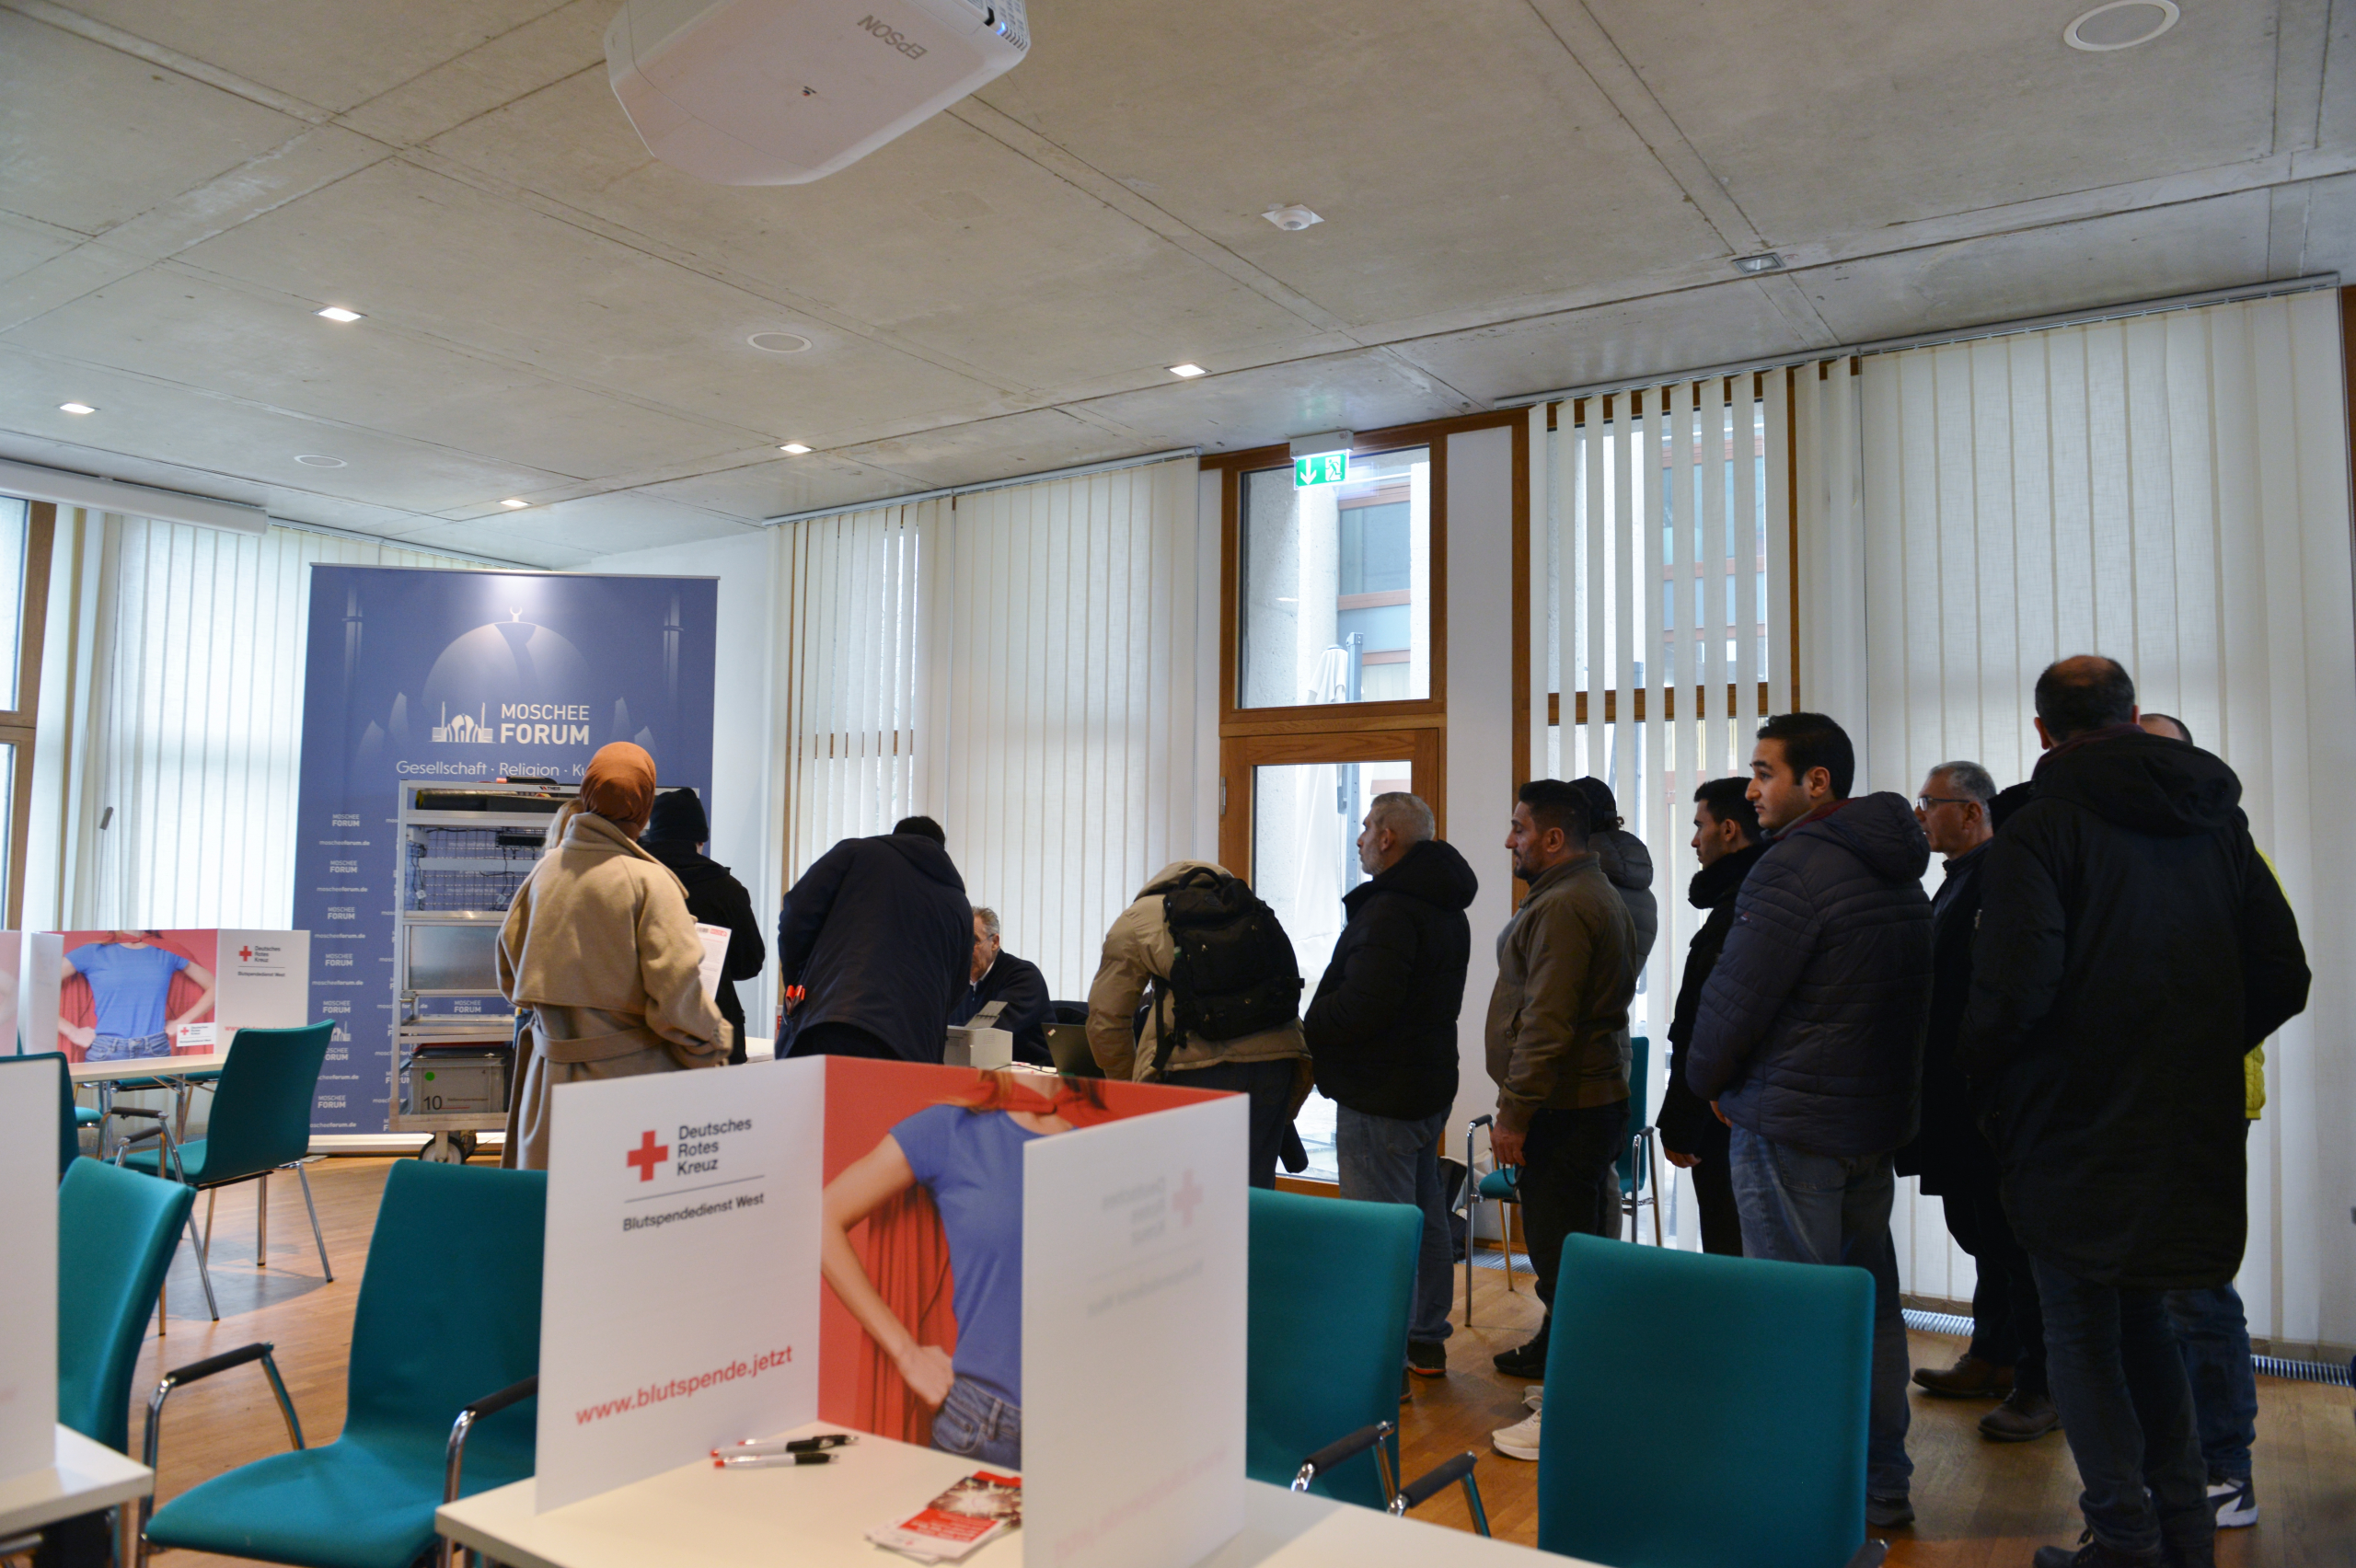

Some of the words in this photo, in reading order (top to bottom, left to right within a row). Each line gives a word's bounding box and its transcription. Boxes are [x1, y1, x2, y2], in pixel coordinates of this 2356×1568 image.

[857, 15, 928, 60] EPSON
[501, 703, 590, 721] MOSCHEE
[500, 723, 589, 745] FORUM
[396, 760, 487, 775] Gesellschaft
[499, 762, 560, 777] Religion
[423, 1095, 443, 1111] 10
[678, 1118, 752, 1140] Deutsches
[677, 1140, 720, 1159] Rotes
[676, 1159, 719, 1176] Kreuz
[622, 1198, 733, 1232] Blutspendedienst
[735, 1193, 765, 1208] West
[575, 1345, 792, 1425] www.blutspende.jetzt
